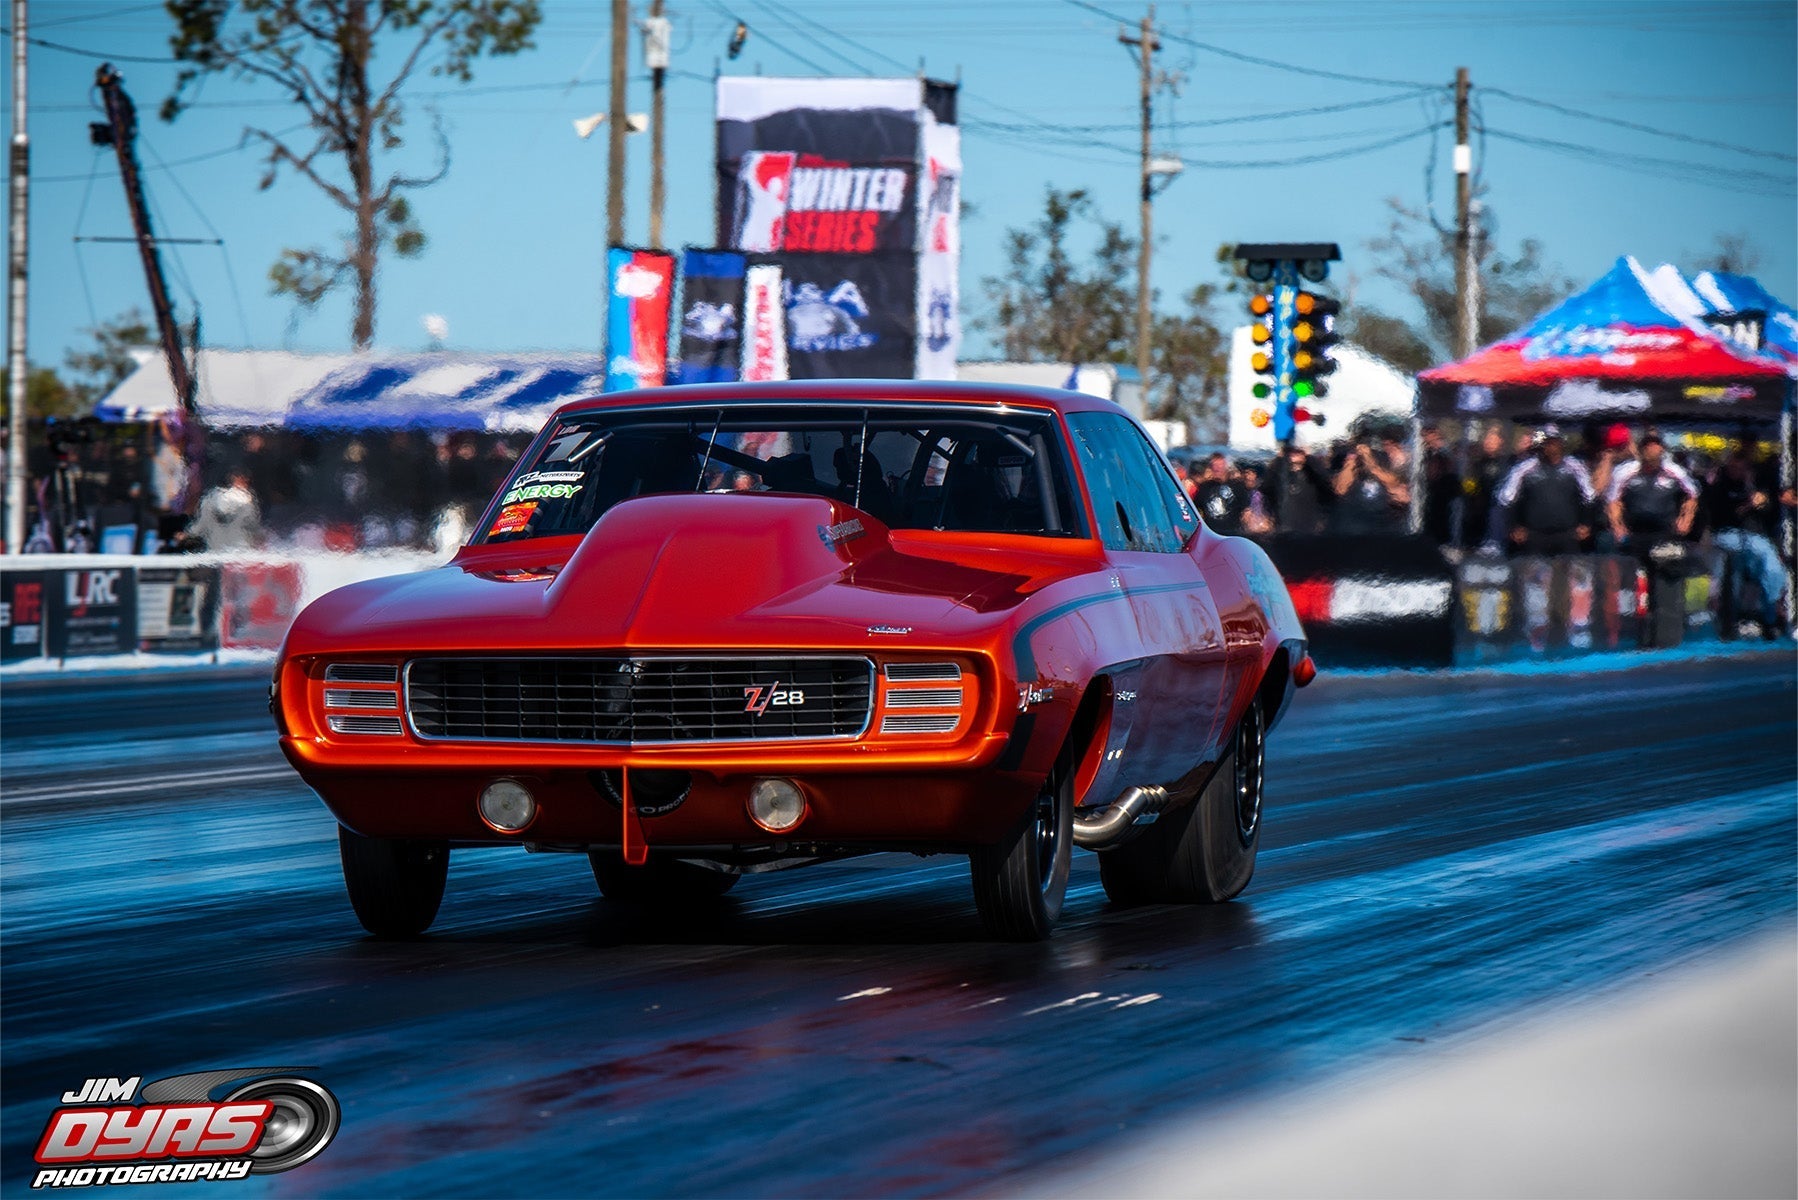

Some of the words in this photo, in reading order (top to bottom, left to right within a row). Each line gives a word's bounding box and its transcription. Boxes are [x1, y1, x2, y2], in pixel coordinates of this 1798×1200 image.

[790, 167, 907, 212] WINTER
[784, 209, 880, 252] SERIES
[502, 484, 583, 505] ENERGY
[744, 680, 805, 717] Z/28
